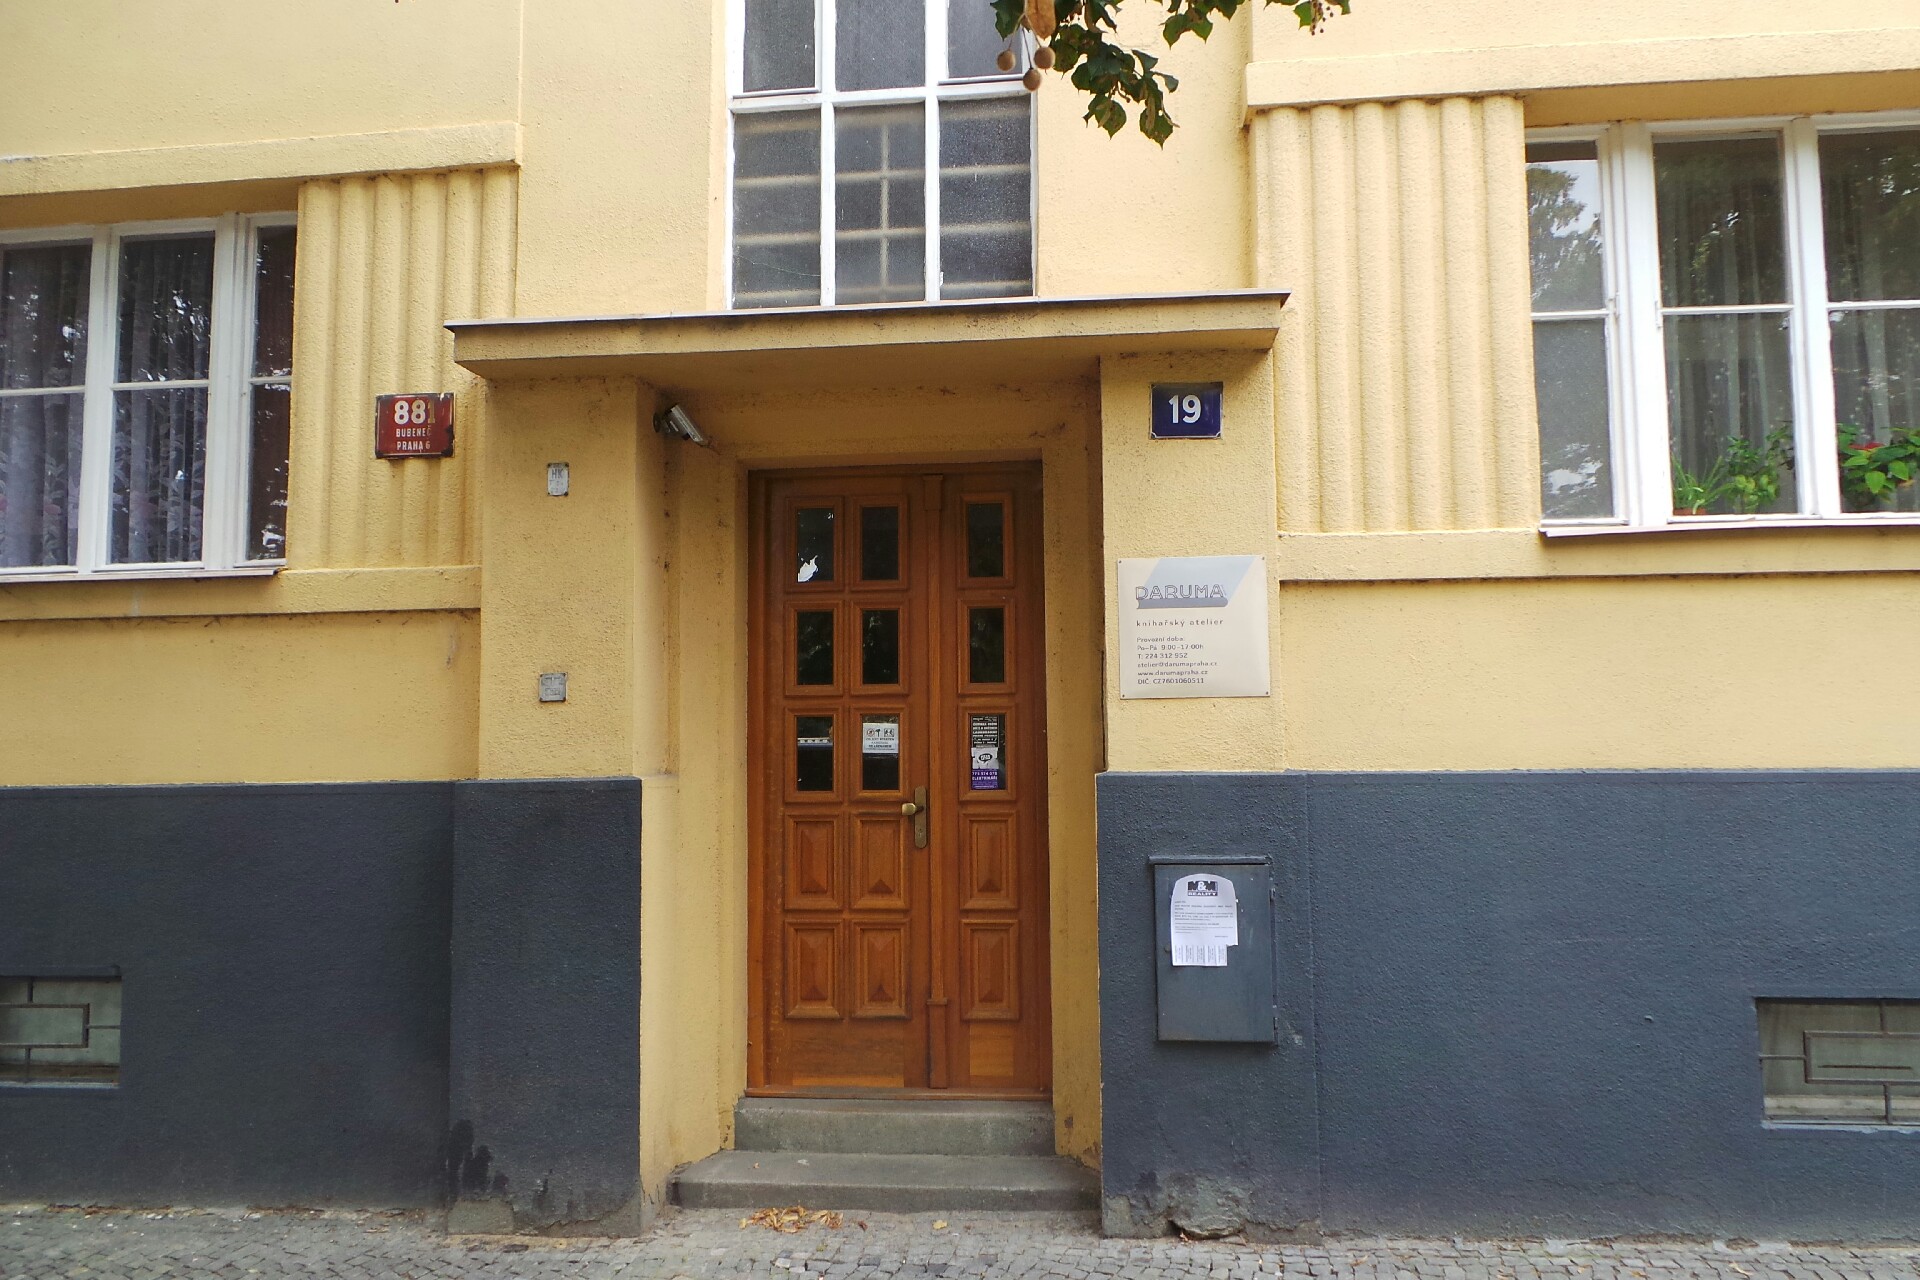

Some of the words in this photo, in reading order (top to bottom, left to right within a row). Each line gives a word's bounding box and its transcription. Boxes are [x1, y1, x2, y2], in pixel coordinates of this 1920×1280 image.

[394, 399, 436, 425] 881
[1168, 394, 1202, 424] 19
[396, 441, 424, 451] PRAHA
[425, 441, 431, 450] 6
[1135, 584, 1224, 600] DARUMA
[1136, 619, 1185, 628] knihařský
[1189, 618, 1224, 626] atelier
